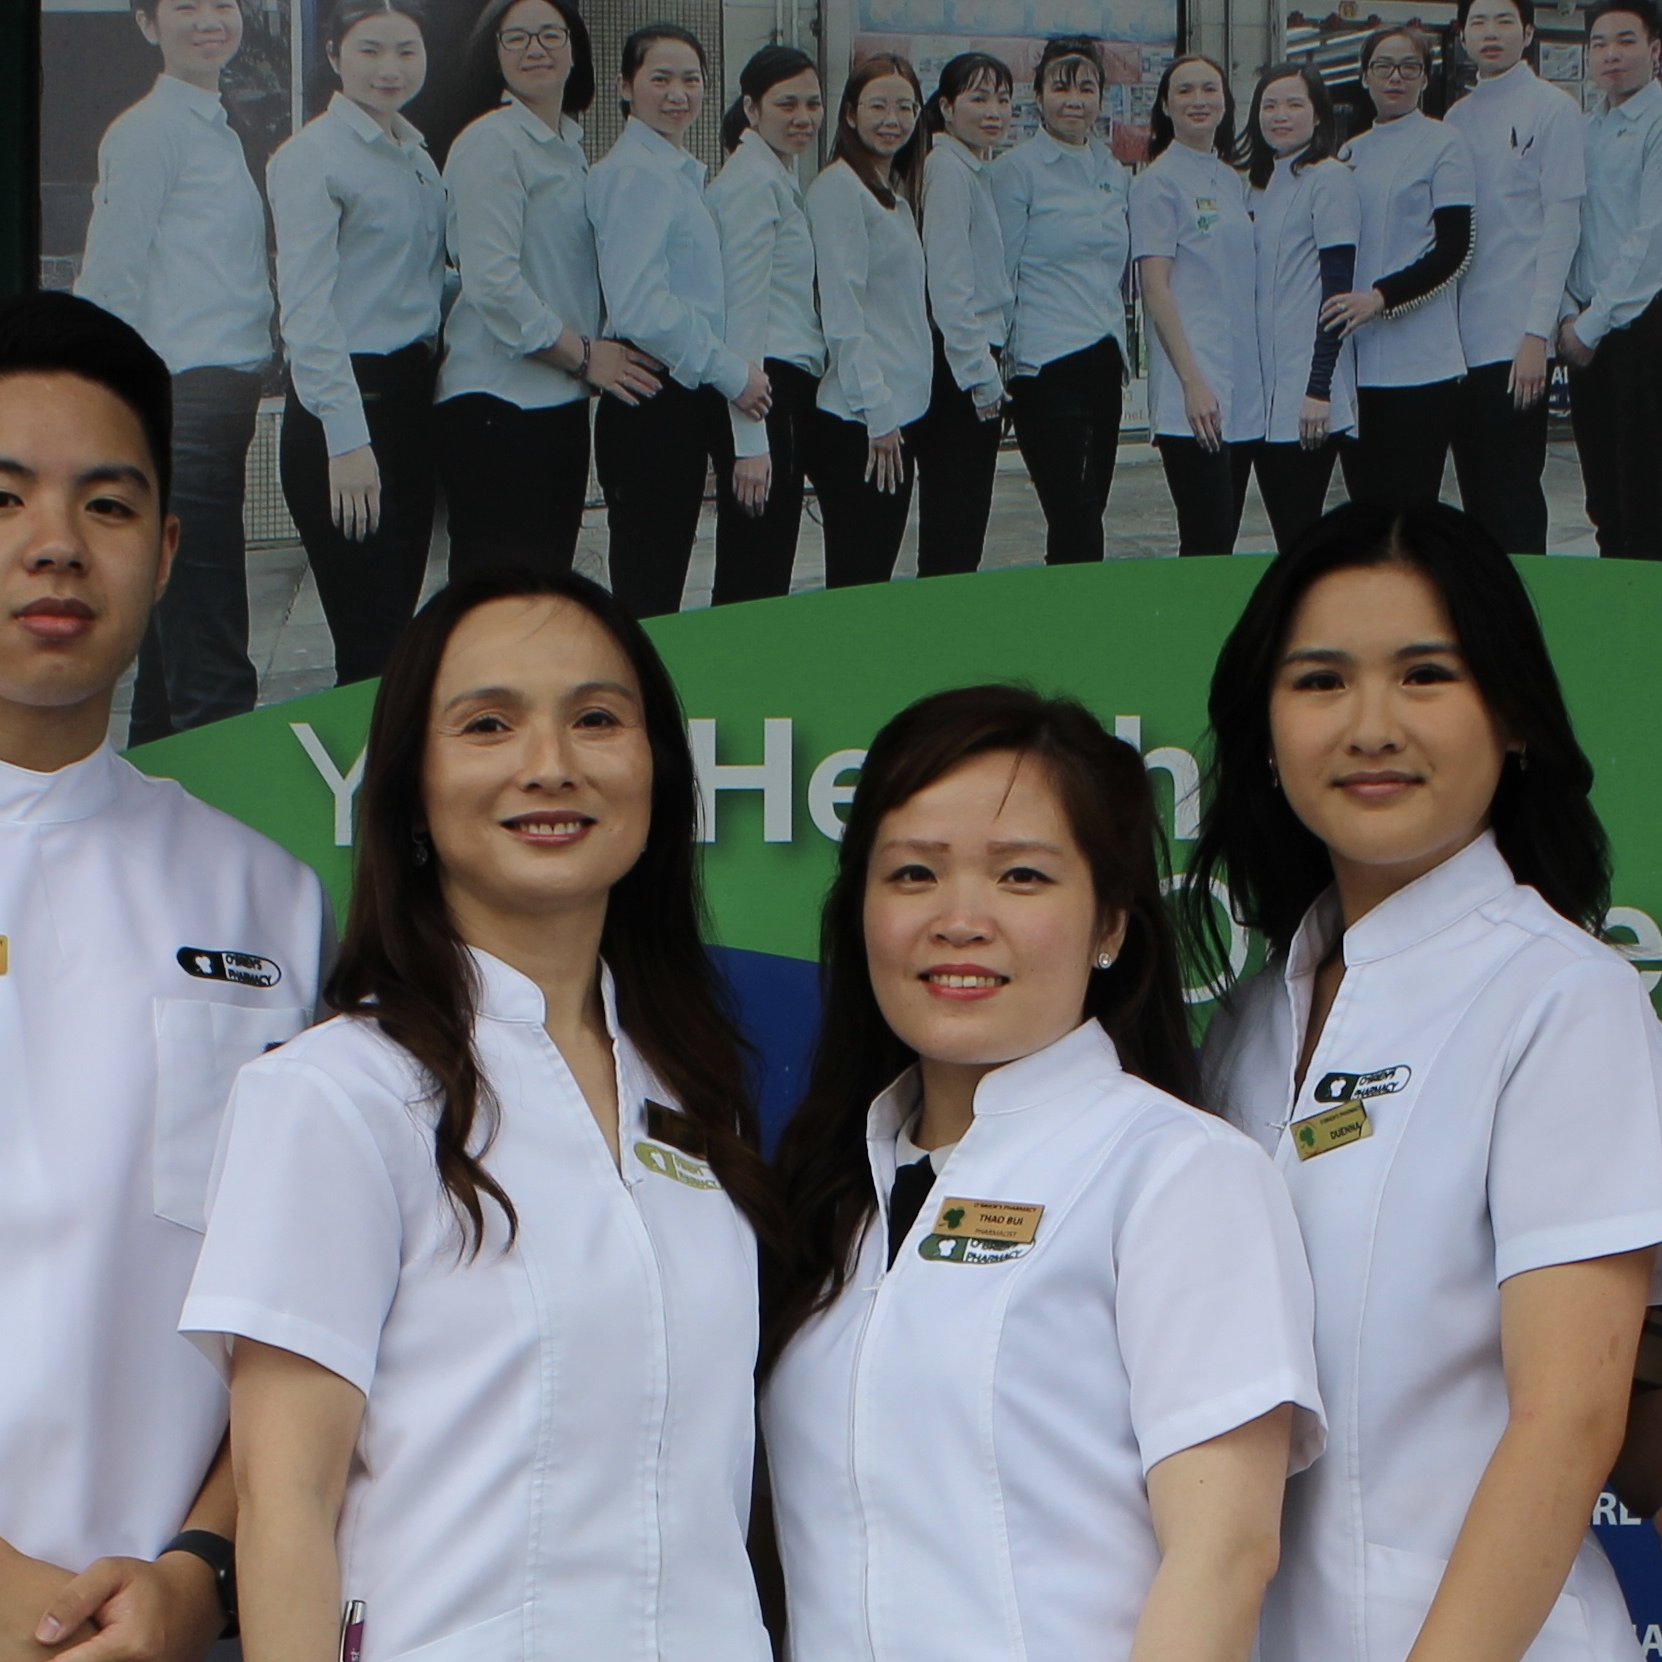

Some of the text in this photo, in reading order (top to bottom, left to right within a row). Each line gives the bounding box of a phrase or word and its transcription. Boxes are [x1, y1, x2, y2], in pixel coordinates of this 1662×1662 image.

[978, 1214, 1024, 1227] THAO BUI
[974, 1228, 1017, 1237] PHARMACIST
